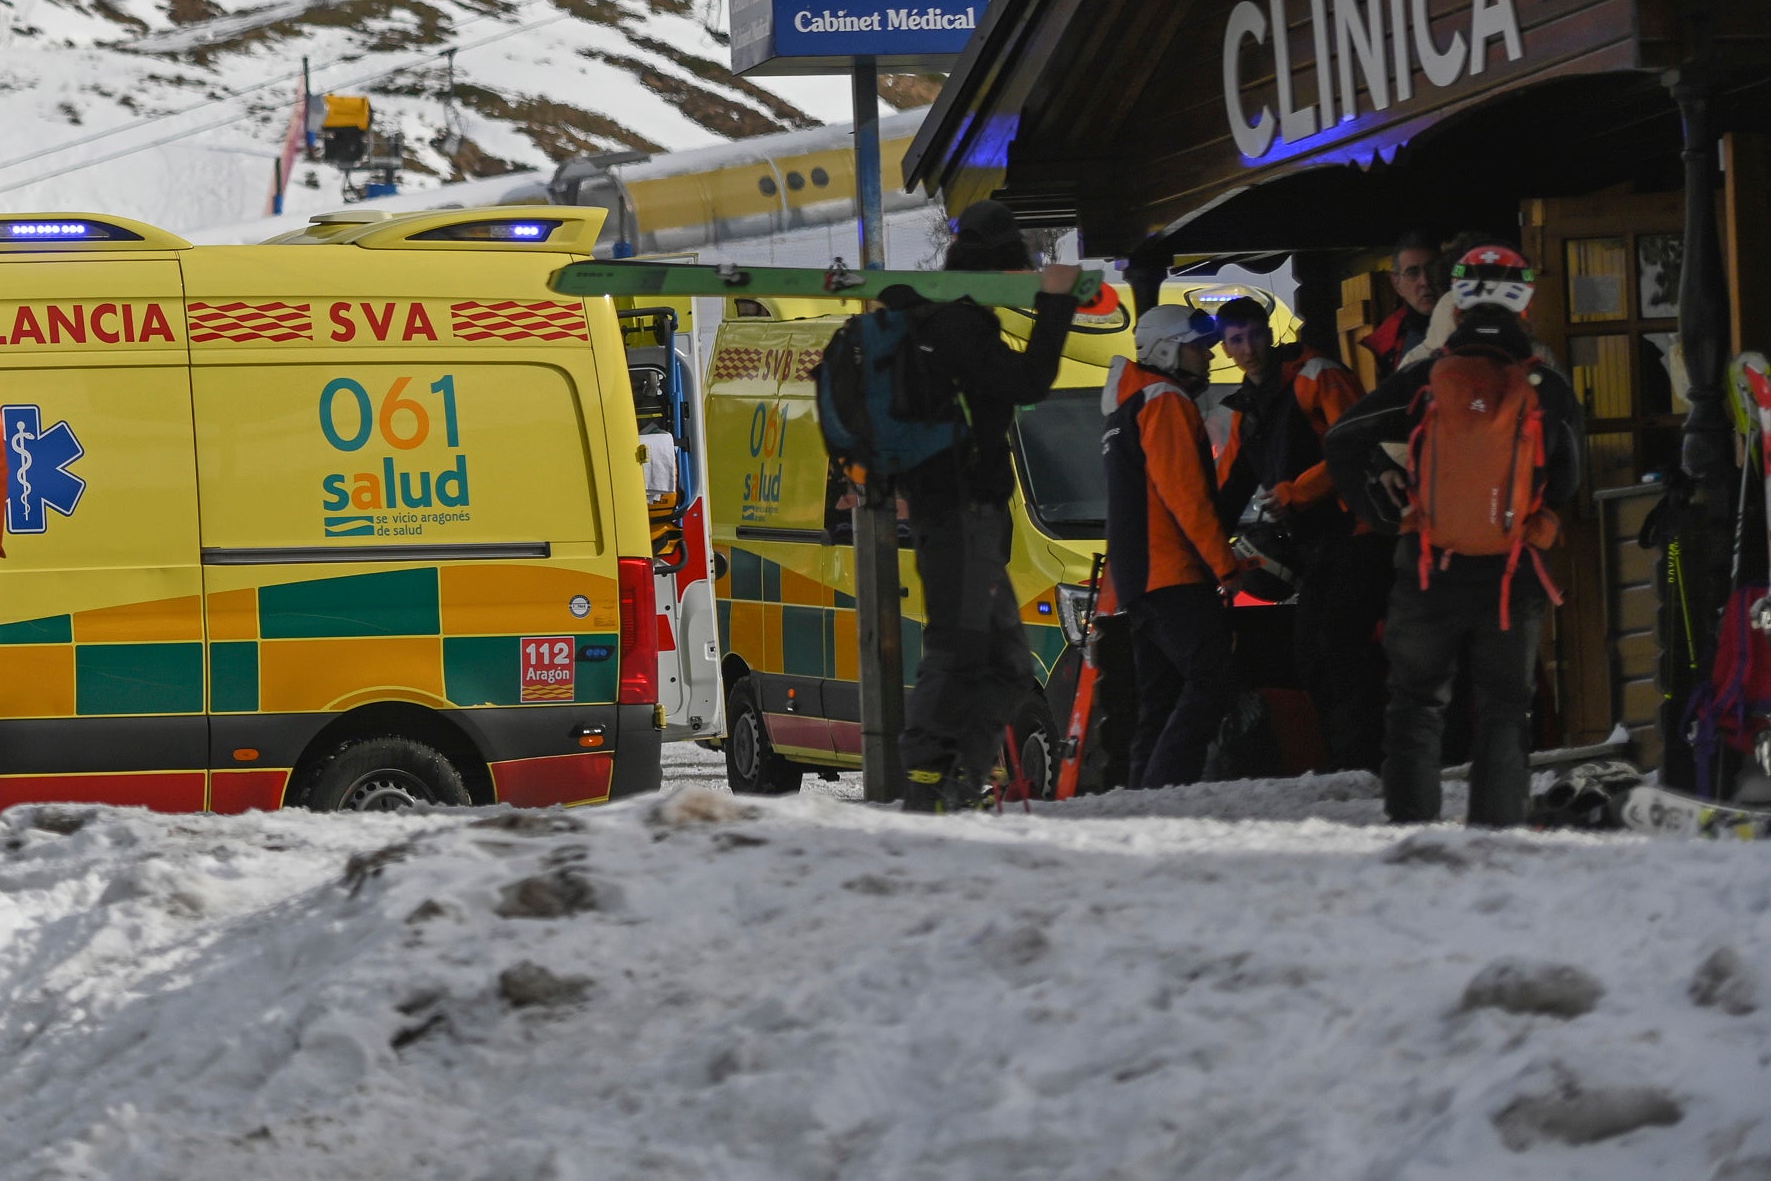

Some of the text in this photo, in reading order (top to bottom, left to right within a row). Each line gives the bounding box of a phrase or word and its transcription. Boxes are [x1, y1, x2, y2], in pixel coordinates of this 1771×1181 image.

[794, 7, 976, 33] Cabinet Médical
[329, 302, 439, 342] SVA
[761, 349, 793, 381] SVB
[319, 374, 459, 452] 061
[750, 402, 789, 458] 061
[322, 455, 470, 511] salud
[743, 462, 782, 503] salud
[377, 524, 422, 536] de salud
[420, 510, 470, 525] aragonés
[525, 642, 570, 665] 112
[526, 667, 570, 683] Aragón
